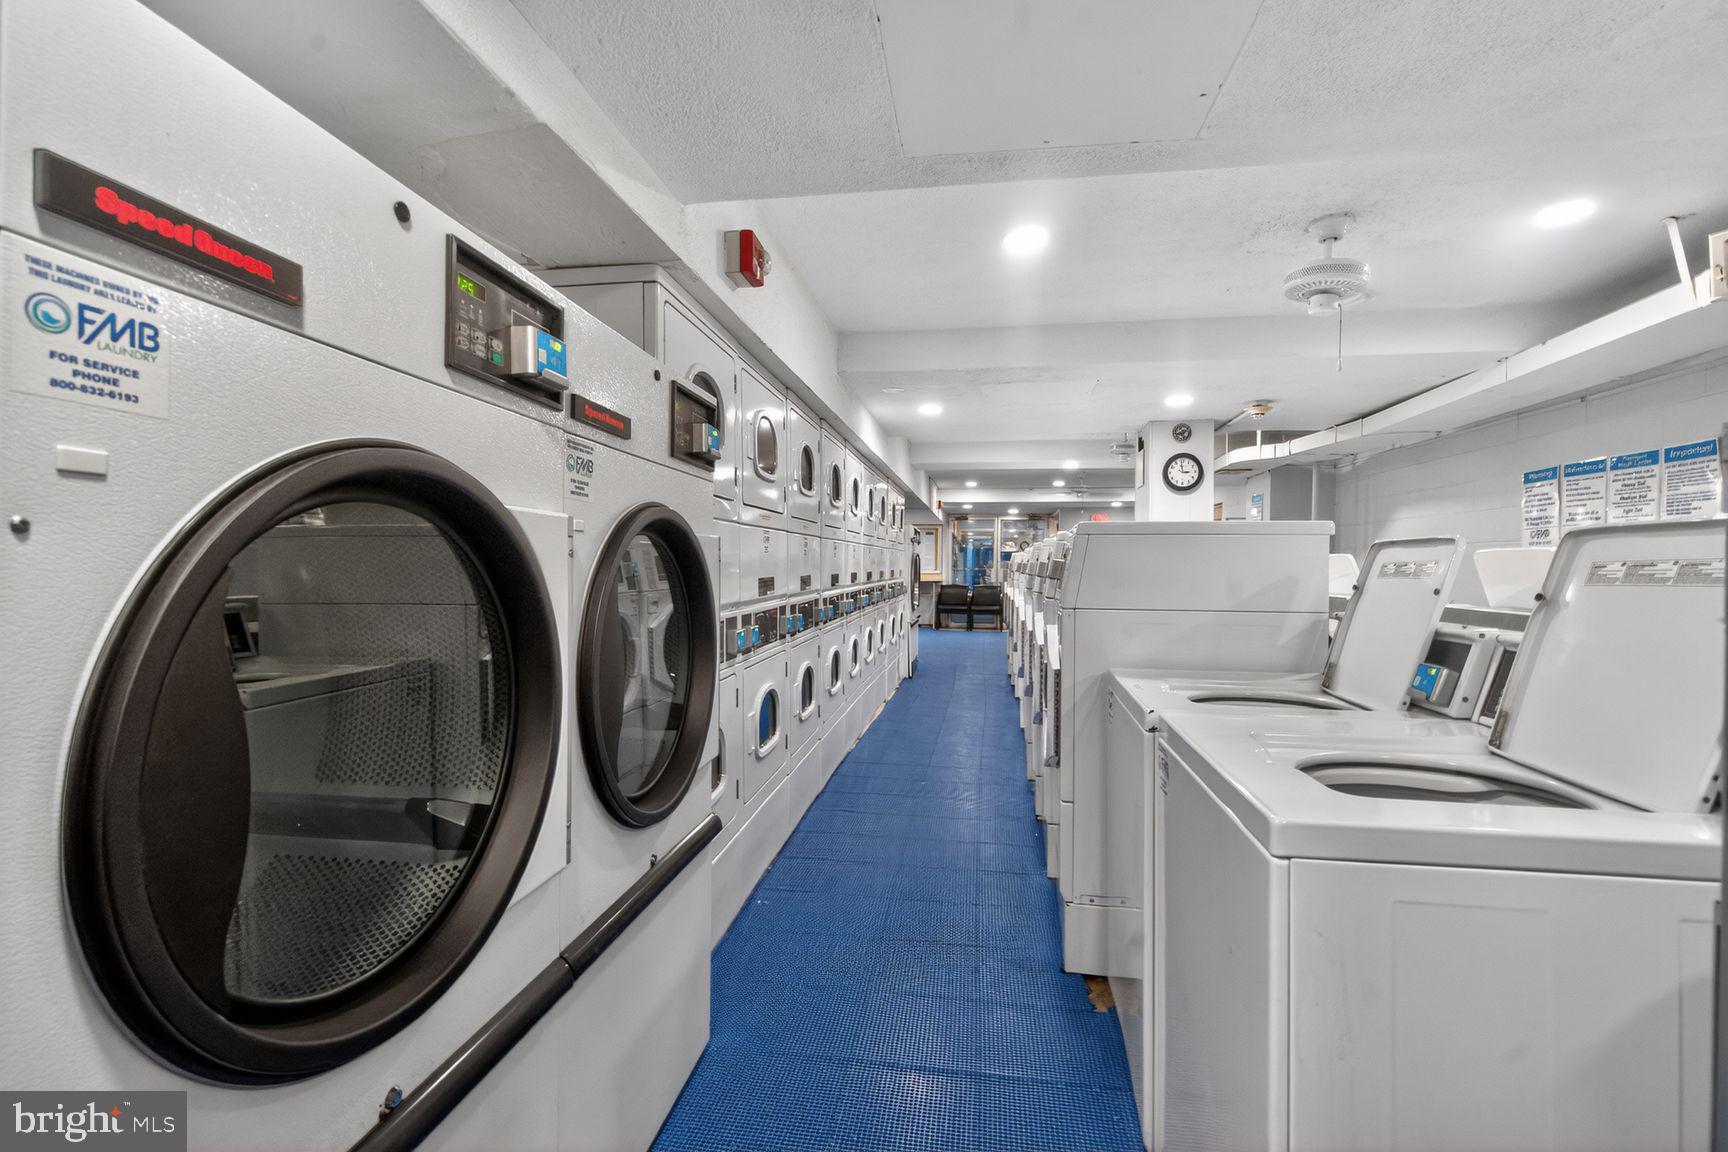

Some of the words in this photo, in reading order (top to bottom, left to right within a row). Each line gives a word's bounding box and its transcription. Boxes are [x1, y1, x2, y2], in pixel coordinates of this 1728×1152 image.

[95, 186, 193, 247] Speed
[194, 229, 273, 281] Queen
[24, 254, 53, 270] THESE
[77, 302, 160, 353] FMB
[49, 350, 79, 365] FOR
[82, 358, 140, 379] SERVICE
[97, 341, 158, 363] LAUNDRY
[72, 369, 120, 387] PHONE
